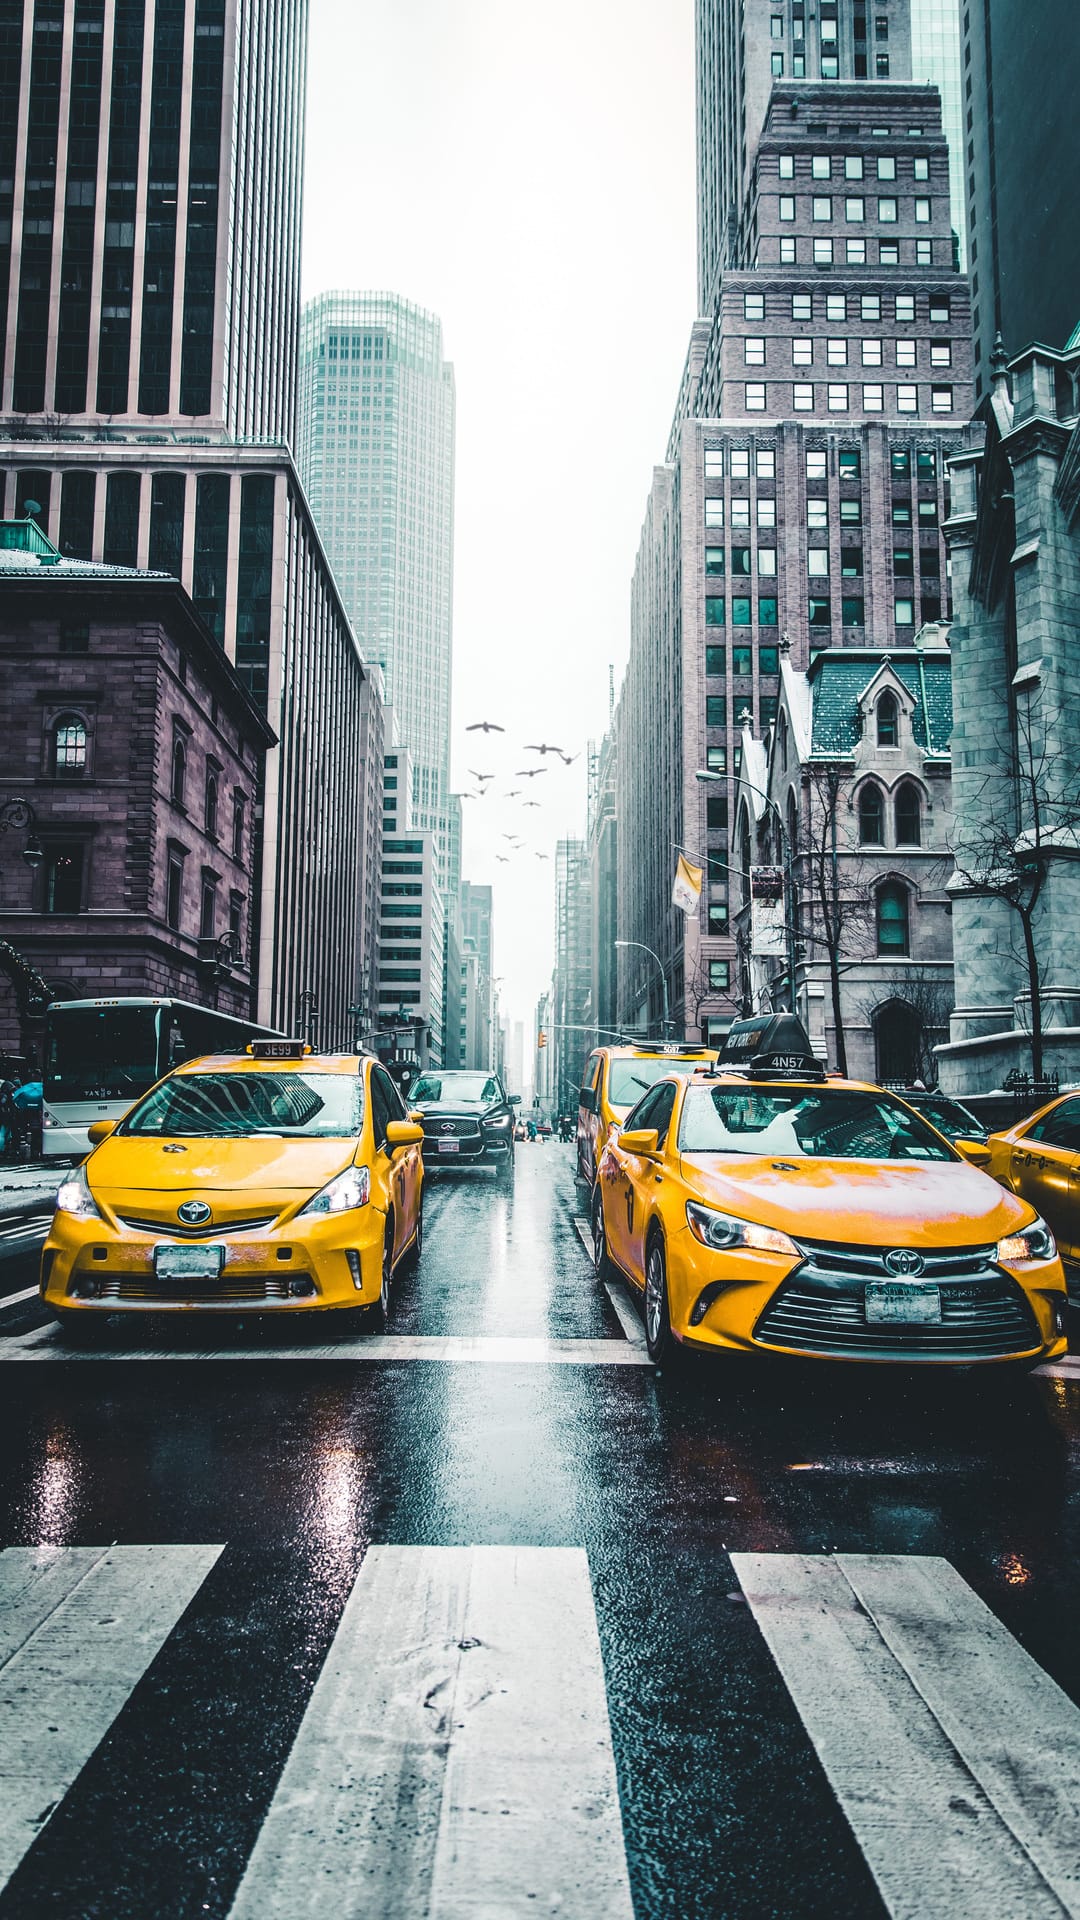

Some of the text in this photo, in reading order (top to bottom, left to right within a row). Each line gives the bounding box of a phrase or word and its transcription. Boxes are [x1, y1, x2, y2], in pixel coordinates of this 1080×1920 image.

[265, 1044, 291, 1055] 3E99
[771, 1056, 804, 1068] 4N57
[882, 1287, 899, 1295] NEW
